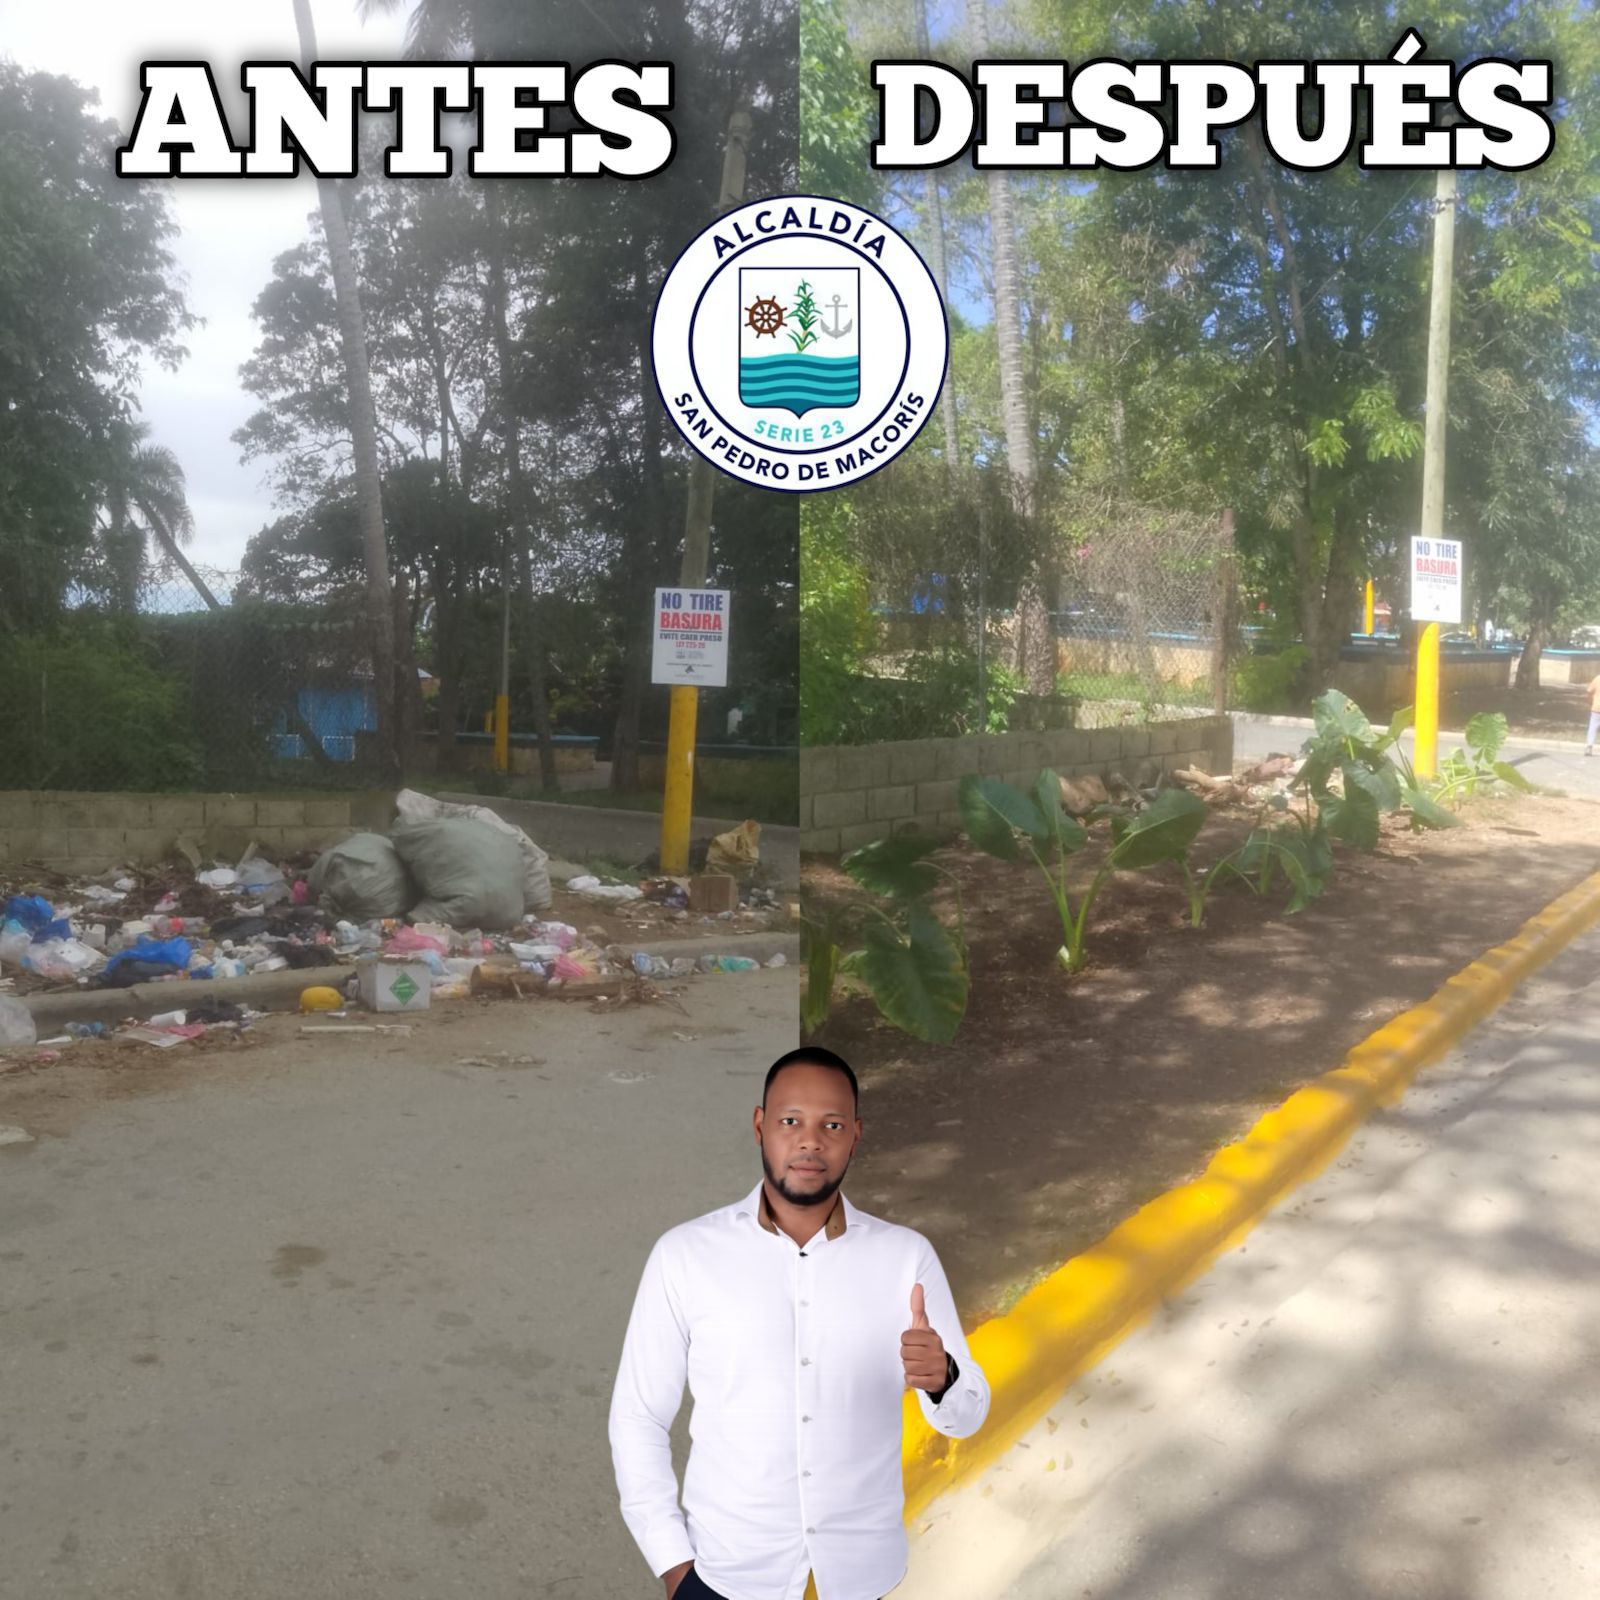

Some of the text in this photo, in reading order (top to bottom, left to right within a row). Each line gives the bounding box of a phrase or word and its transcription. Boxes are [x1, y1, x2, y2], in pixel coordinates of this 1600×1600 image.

[1416, 541, 1457, 559] NO TIRE
[1416, 558, 1457, 575] BASURA
[661, 593, 723, 611] NO TIRE
[660, 612, 722, 630] BASURA
